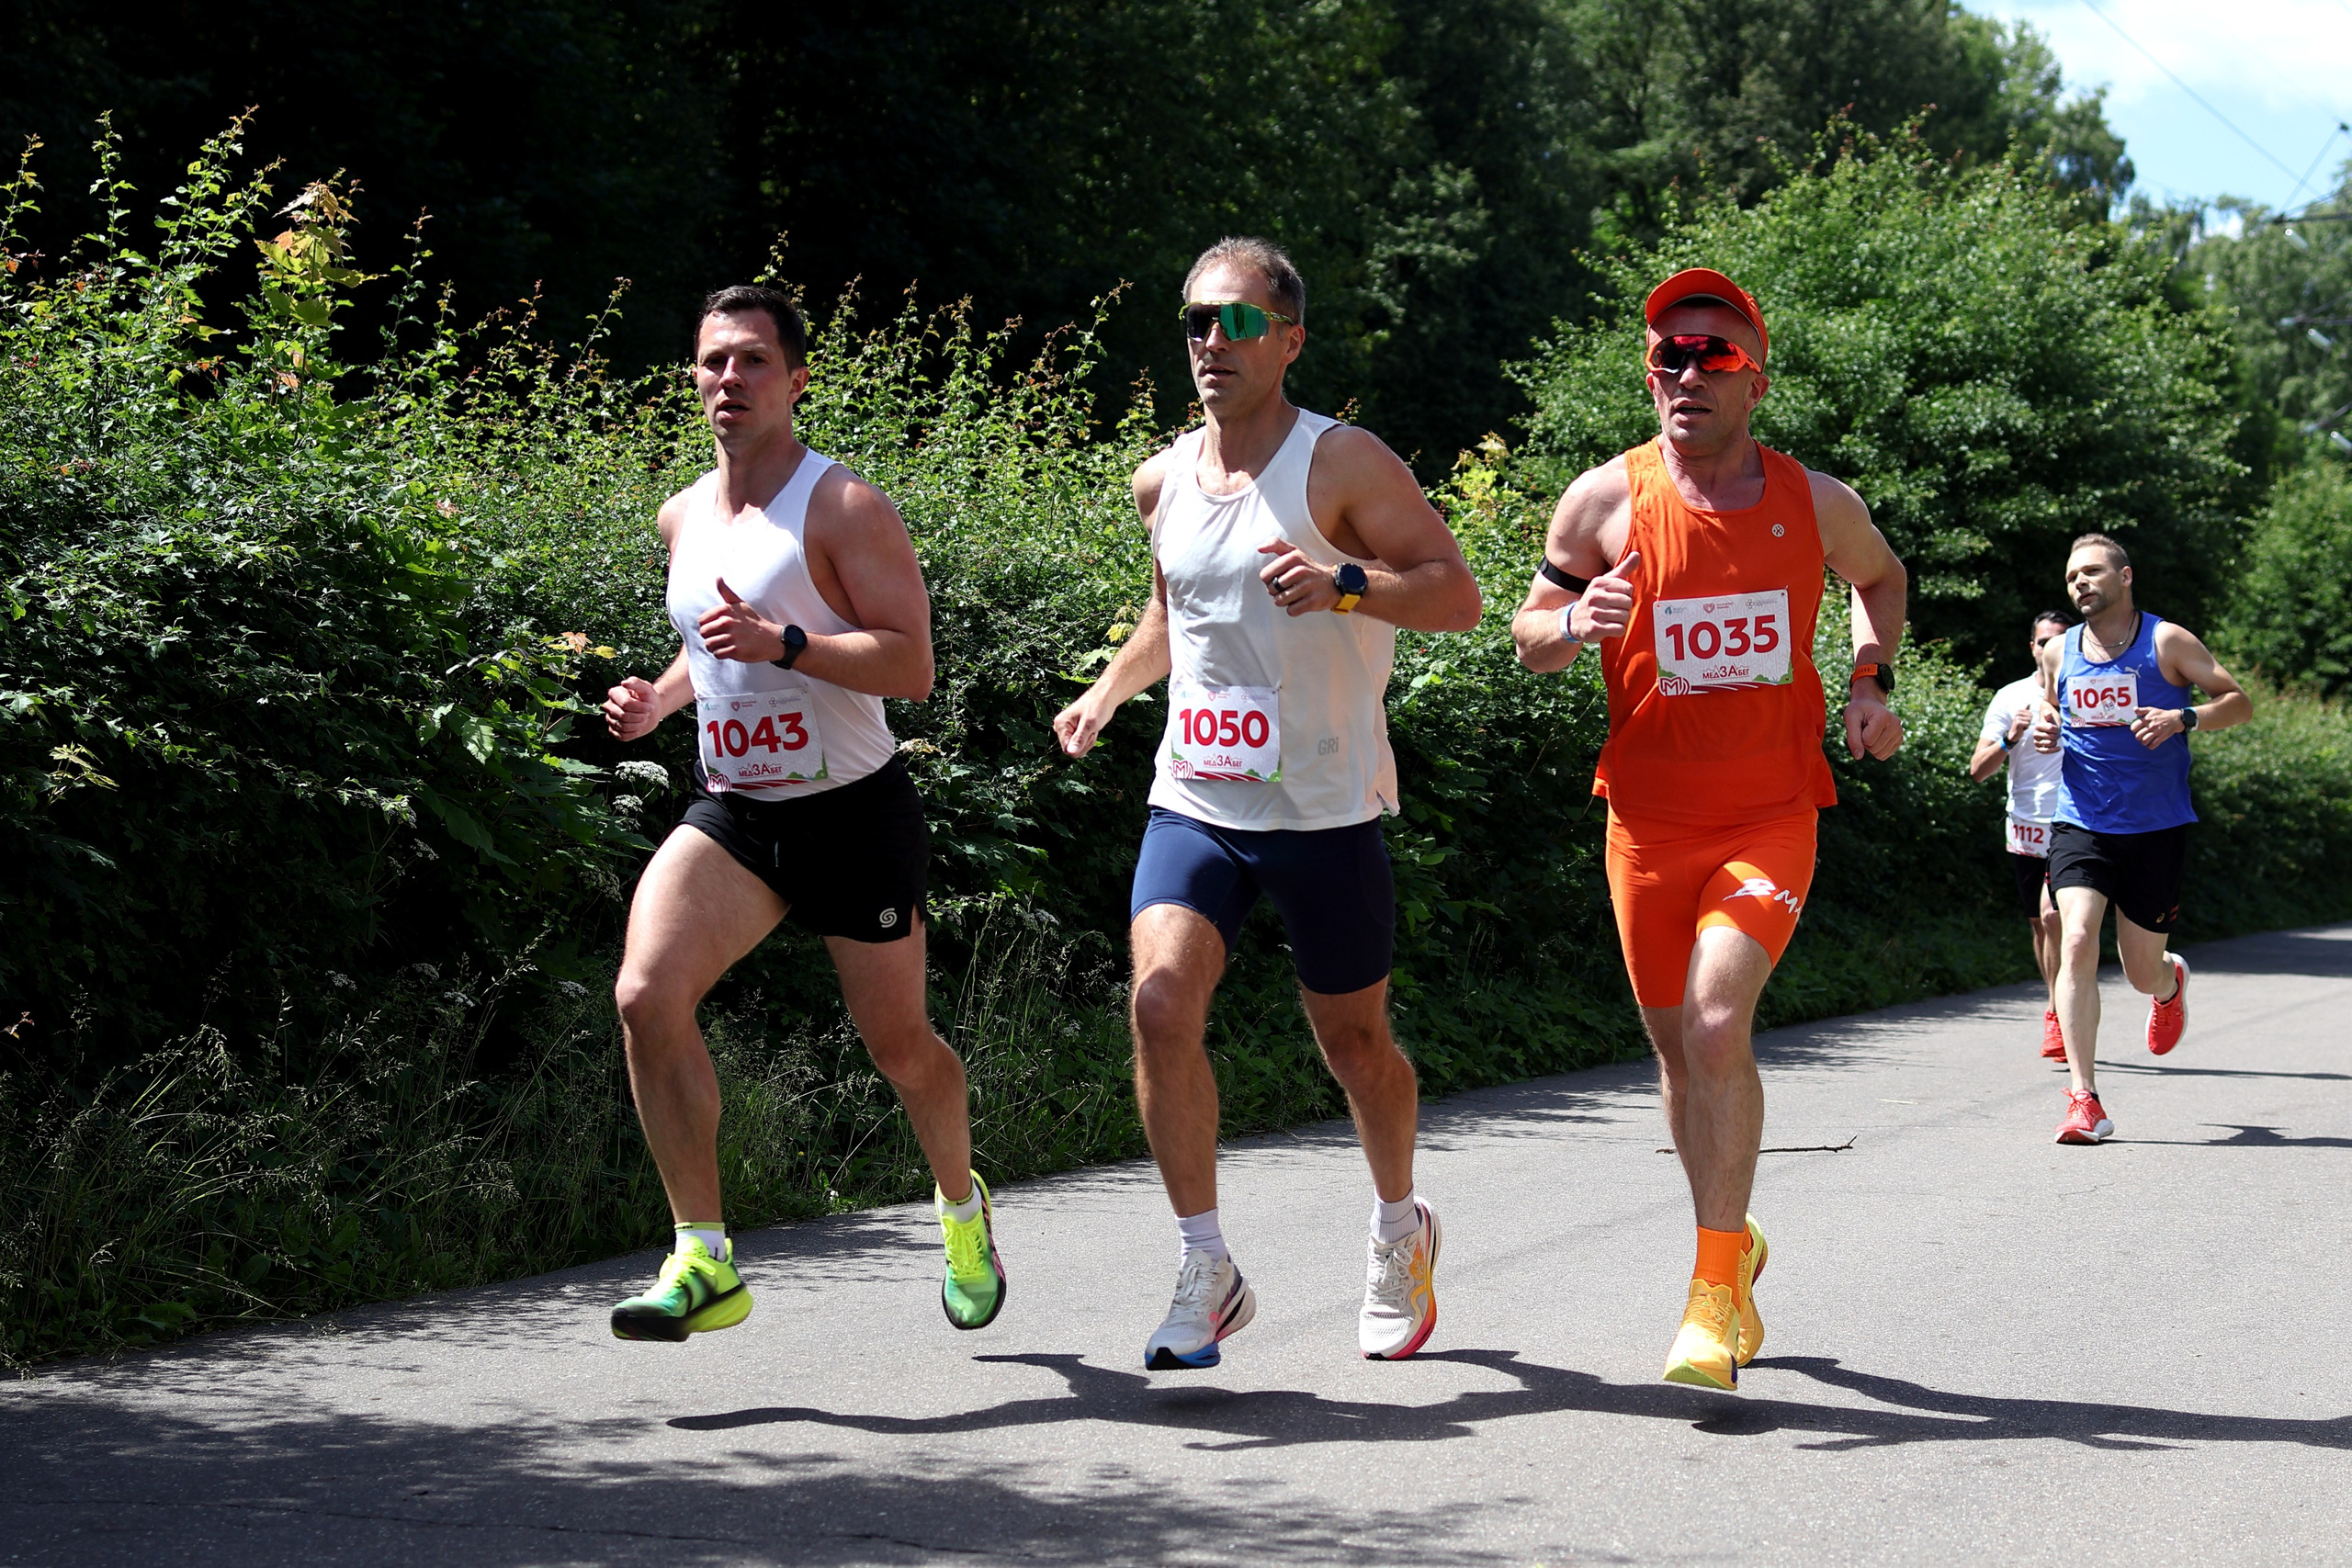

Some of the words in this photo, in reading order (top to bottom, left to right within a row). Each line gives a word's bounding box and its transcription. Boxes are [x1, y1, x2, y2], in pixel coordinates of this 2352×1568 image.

[1665, 614, 1780, 661] 1035
[2073, 685, 2132, 708] 1065
[707, 711, 809, 758] 1043
[1179, 708, 1270, 749] 1050
[2013, 824, 2044, 844] 1112
